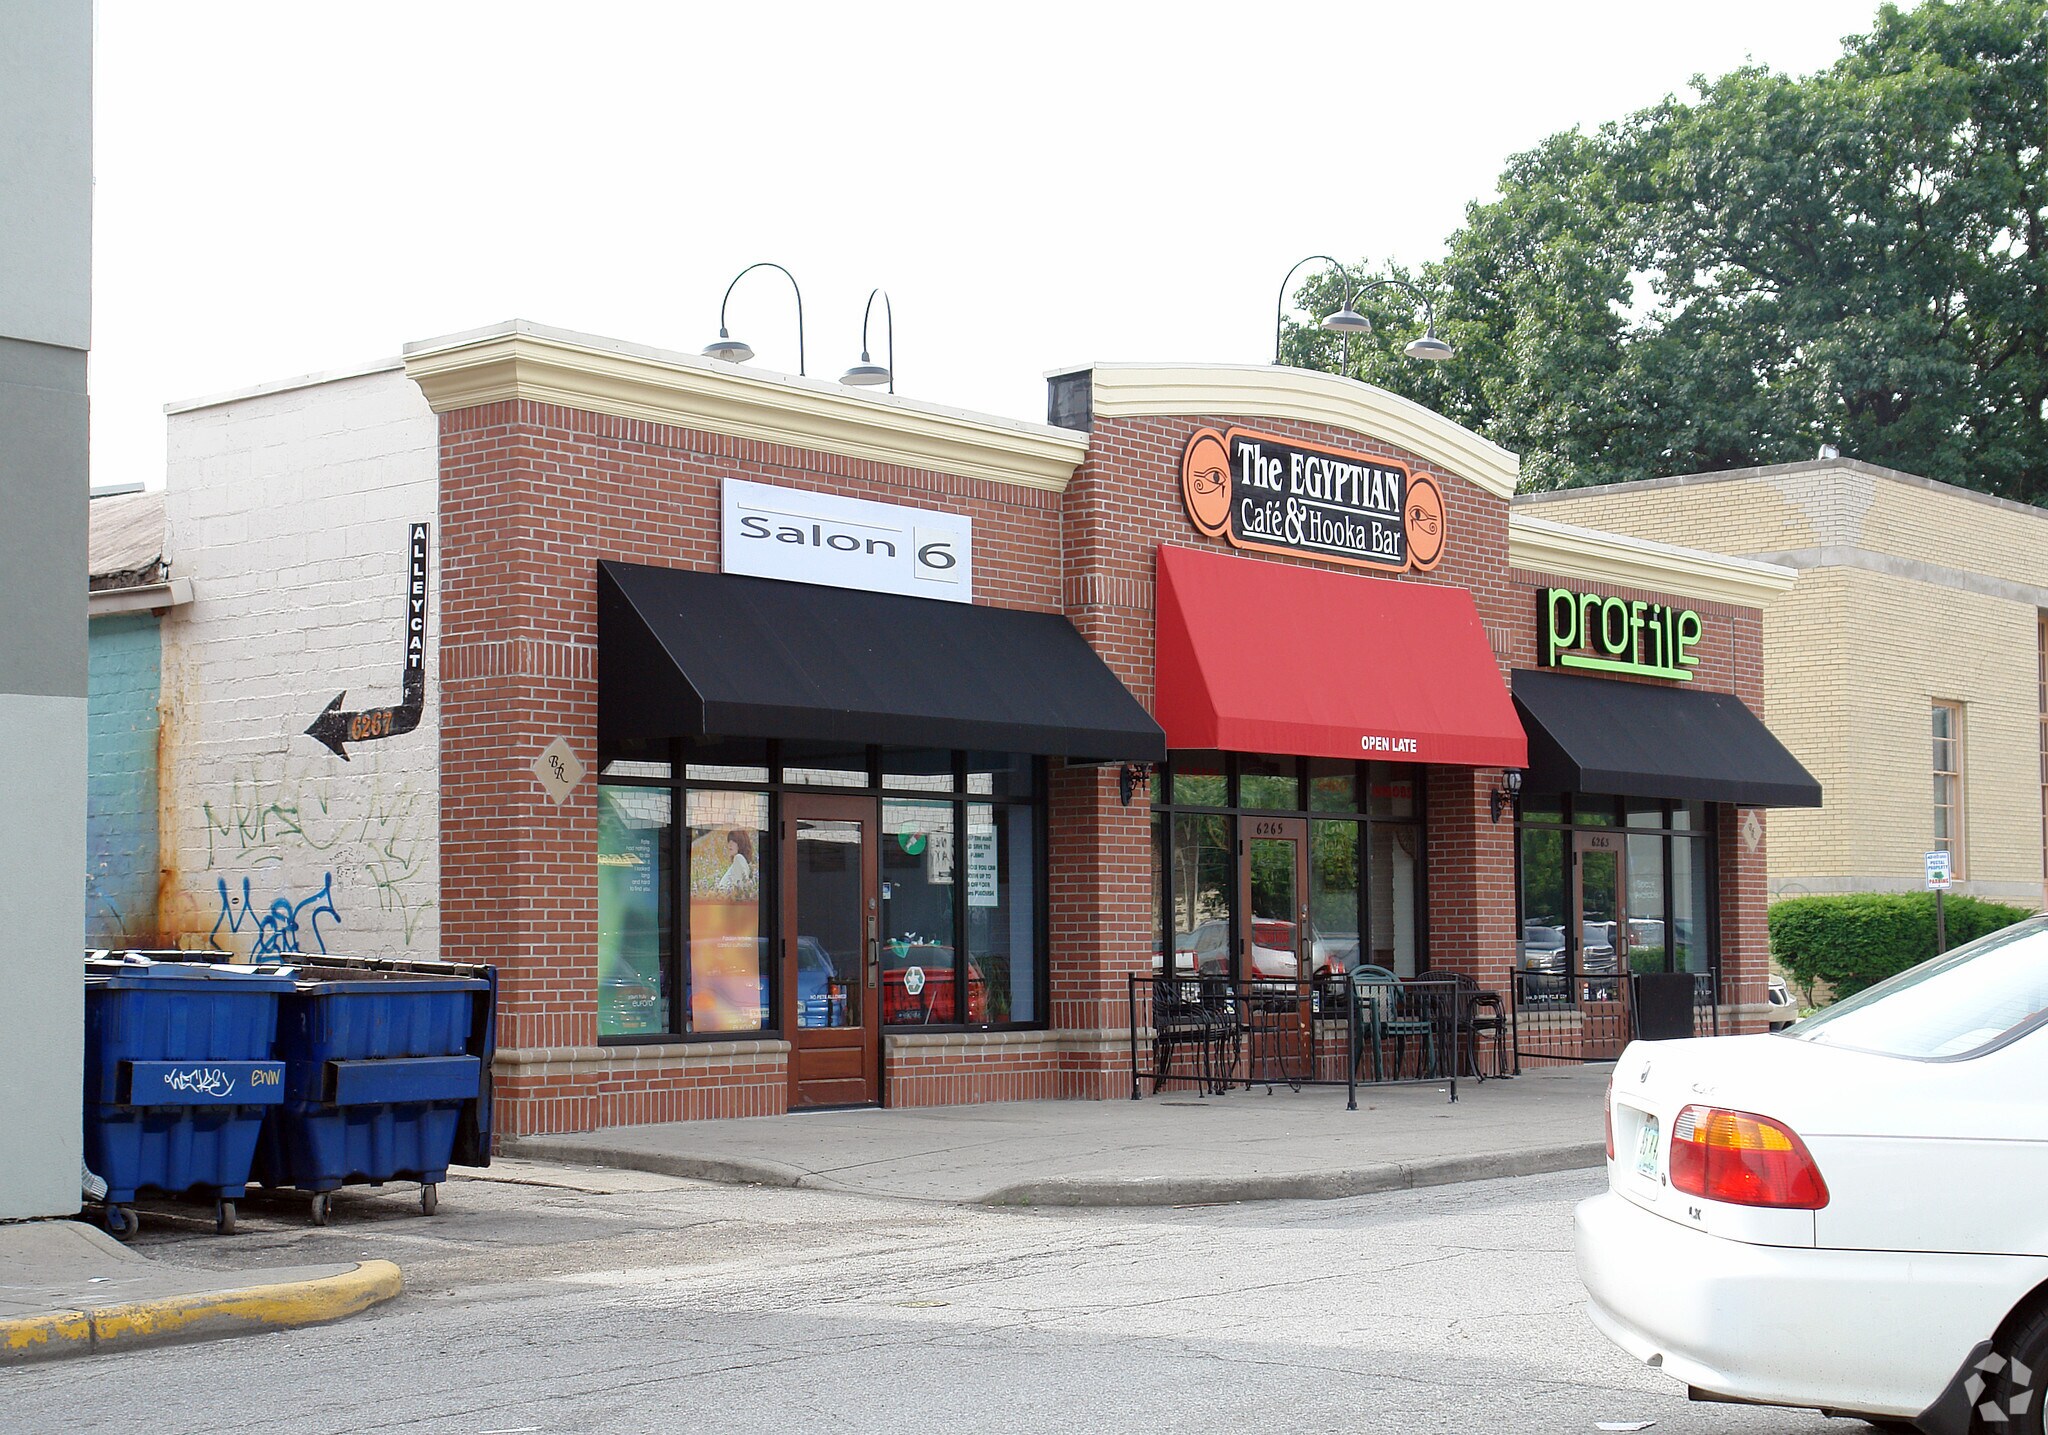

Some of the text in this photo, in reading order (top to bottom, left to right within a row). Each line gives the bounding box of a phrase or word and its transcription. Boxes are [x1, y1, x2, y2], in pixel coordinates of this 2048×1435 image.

[1237, 441, 1400, 513] The EGYPTIAN
[740, 516, 957, 569] Salon 6
[1241, 496, 1400, 555] Café & Hooka Bar
[409, 526, 426, 668] ALLEYCAT
[1548, 587, 1703, 671] profile
[351, 710, 393, 741] 6267
[1361, 735, 1417, 753] OPEN LATE
[1256, 822, 1283, 835] 6265
